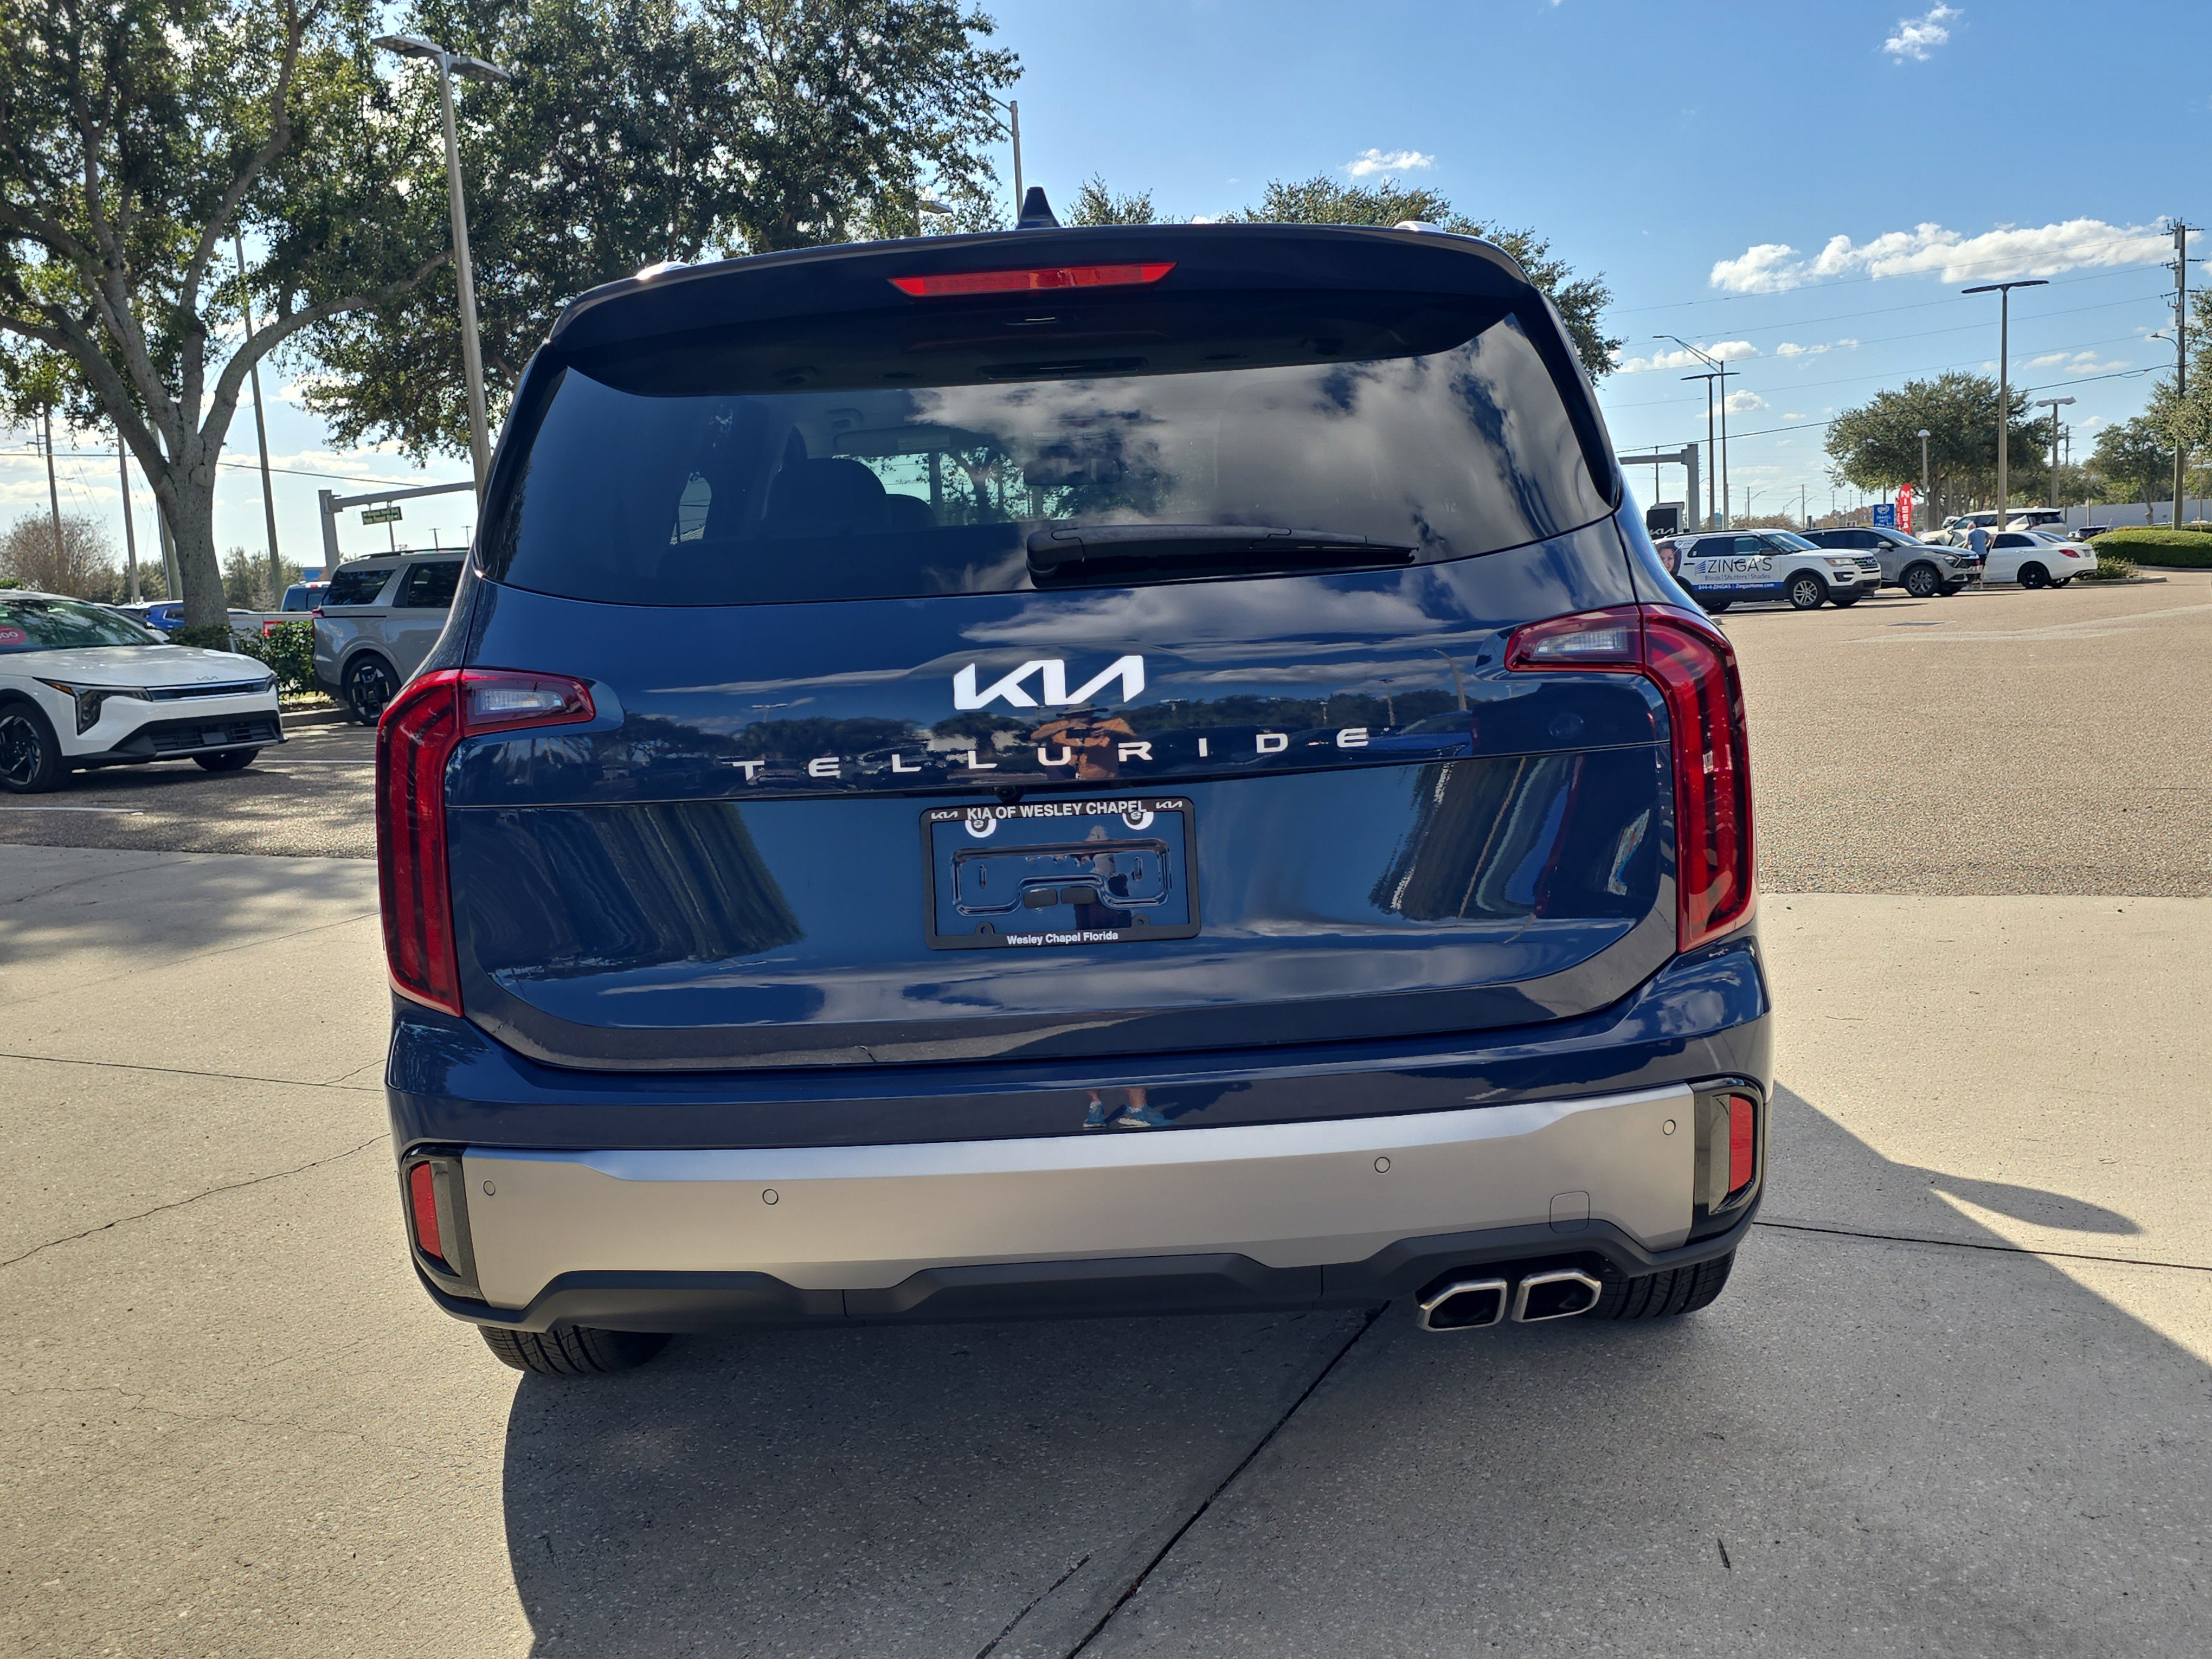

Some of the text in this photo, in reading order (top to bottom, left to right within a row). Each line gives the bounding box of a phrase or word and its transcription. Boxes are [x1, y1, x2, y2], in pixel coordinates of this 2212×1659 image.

[1901, 490, 1910, 534] NISSA
[1708, 557, 1772, 573] ZINGA'S
[954, 655, 1144, 710] KIA
[732, 727, 1369, 781] TELLURIDE
[967, 807, 992, 820] KIA
[995, 806, 1016, 819] OF
[1019, 803, 1082, 818] WESLEY
[1085, 800, 1147, 815] CHAPEL
[1007, 930, 1118, 946] Wesley Chapel Florida
